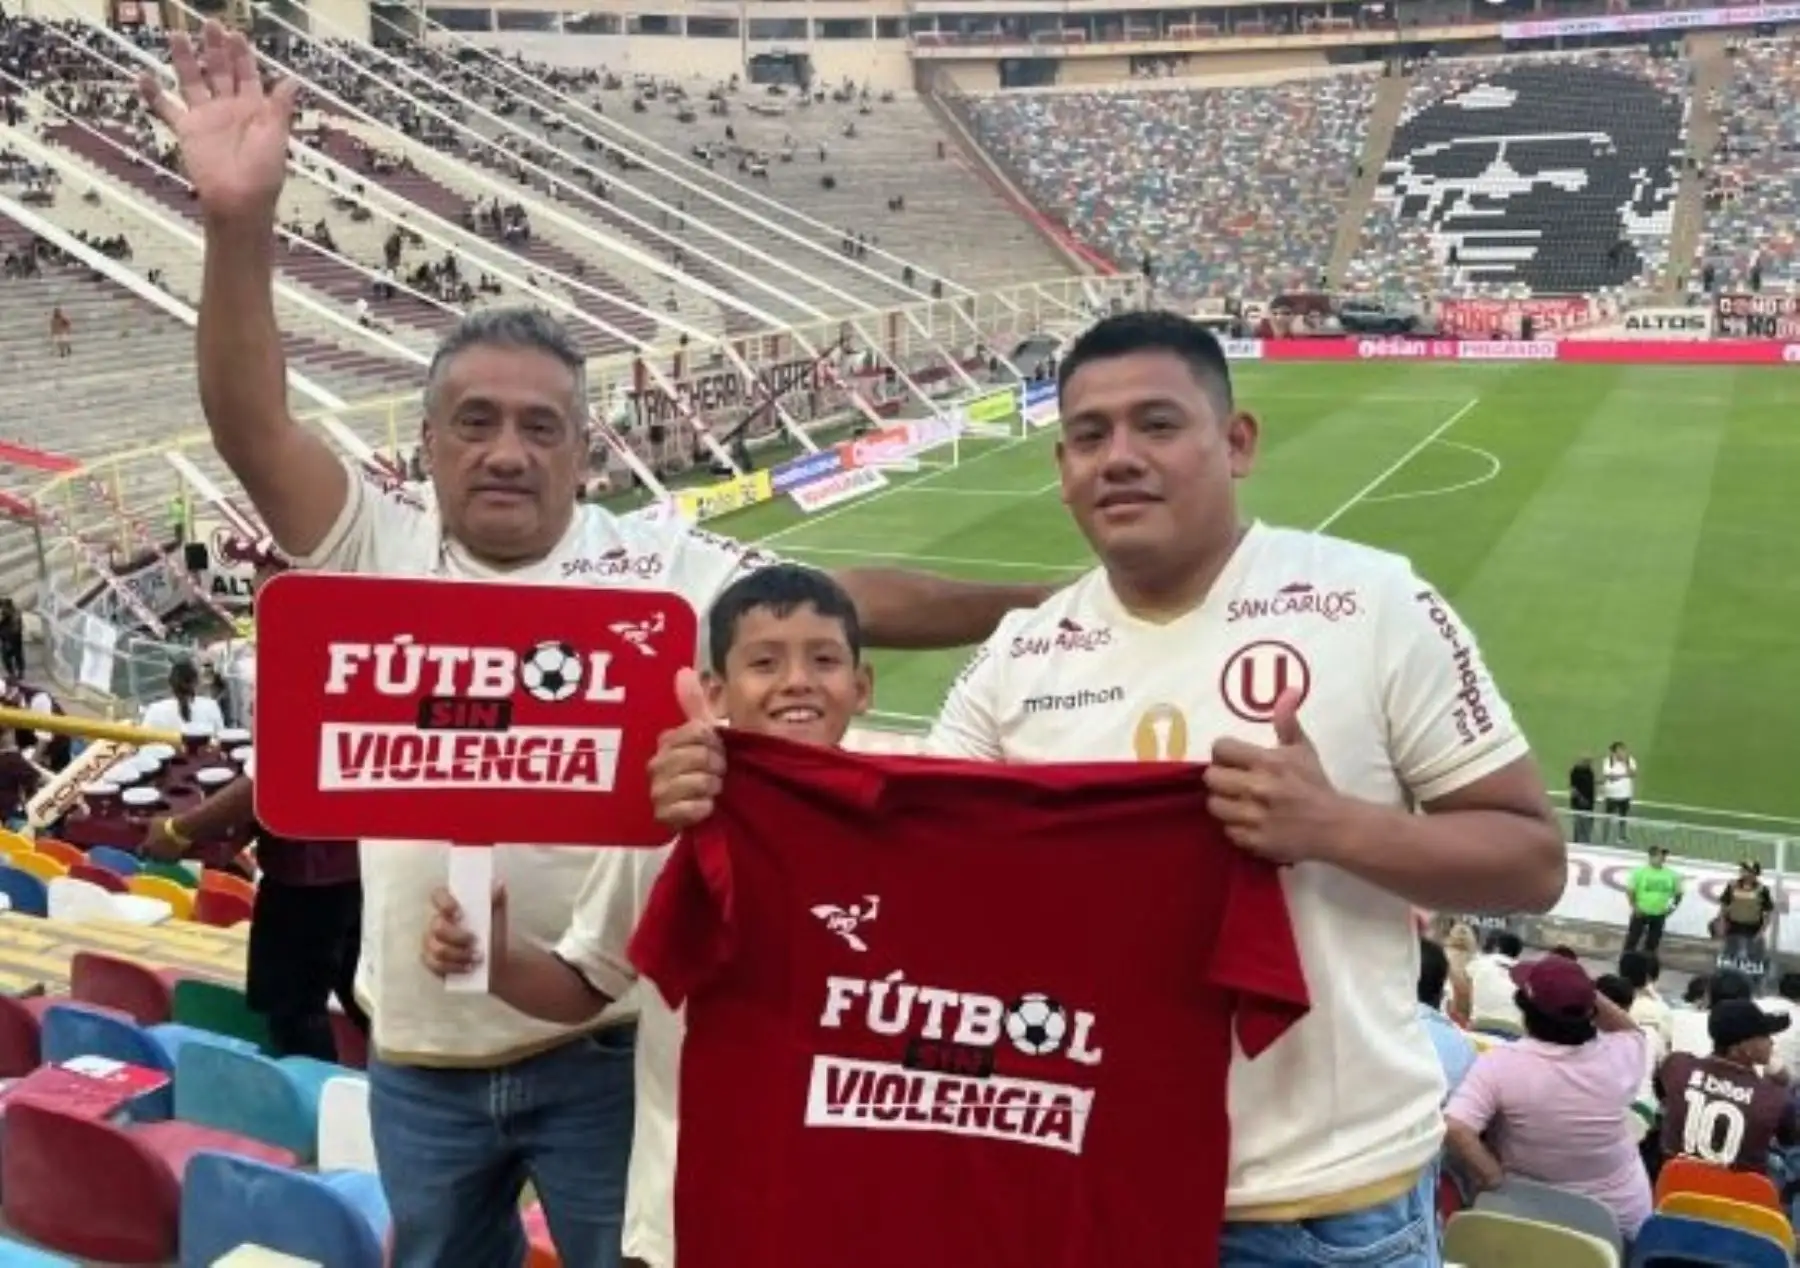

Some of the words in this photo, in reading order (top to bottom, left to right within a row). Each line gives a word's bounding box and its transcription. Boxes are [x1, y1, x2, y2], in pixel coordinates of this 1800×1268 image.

[1624, 313, 1706, 330] ALTOS
[1227, 598, 1269, 622] SAN
[324, 633, 626, 703] FÚTBOL
[1010, 636, 1050, 658] SAN
[1022, 685, 1126, 714] marathon
[1240, 655, 1288, 711] U
[428, 703, 499, 728] SIN
[336, 731, 599, 783] VIOLENCIA
[820, 969, 1103, 1064] FÚTBOL
[826, 1065, 1074, 1143] VIOLENCIA
[1683, 1087, 1745, 1165] 10
